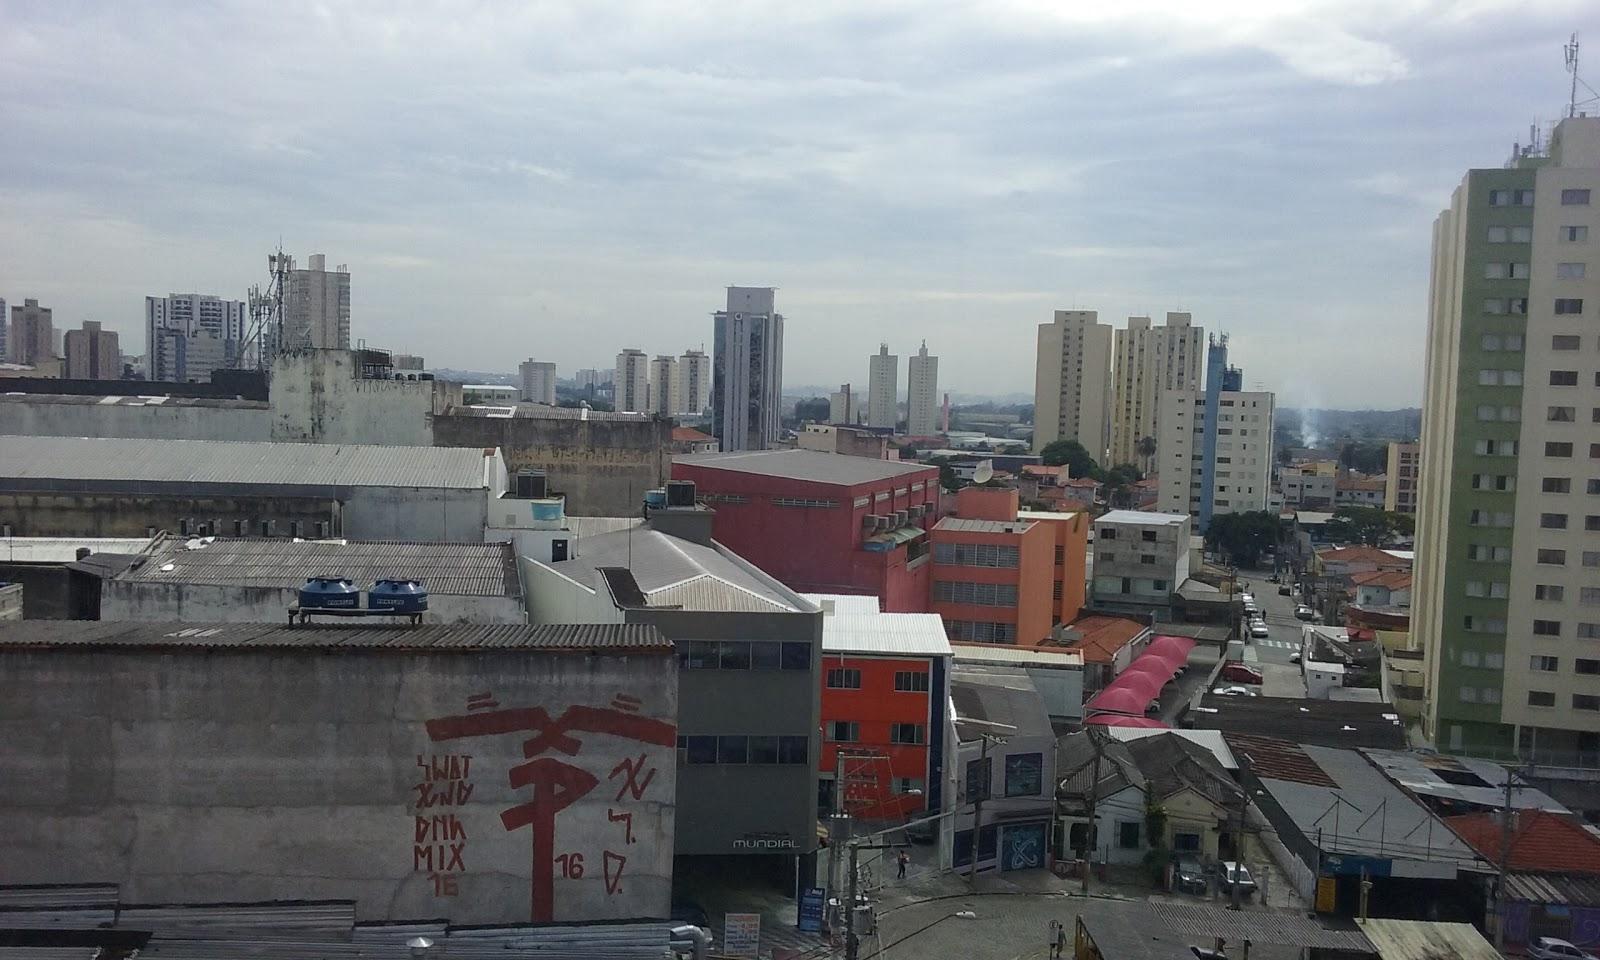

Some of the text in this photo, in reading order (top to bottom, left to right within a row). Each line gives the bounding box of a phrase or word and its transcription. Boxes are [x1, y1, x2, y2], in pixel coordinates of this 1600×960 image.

[414, 843, 466, 872] MIX
[733, 839, 801, 848] MUNDIAL
[554, 852, 584, 880] 16
